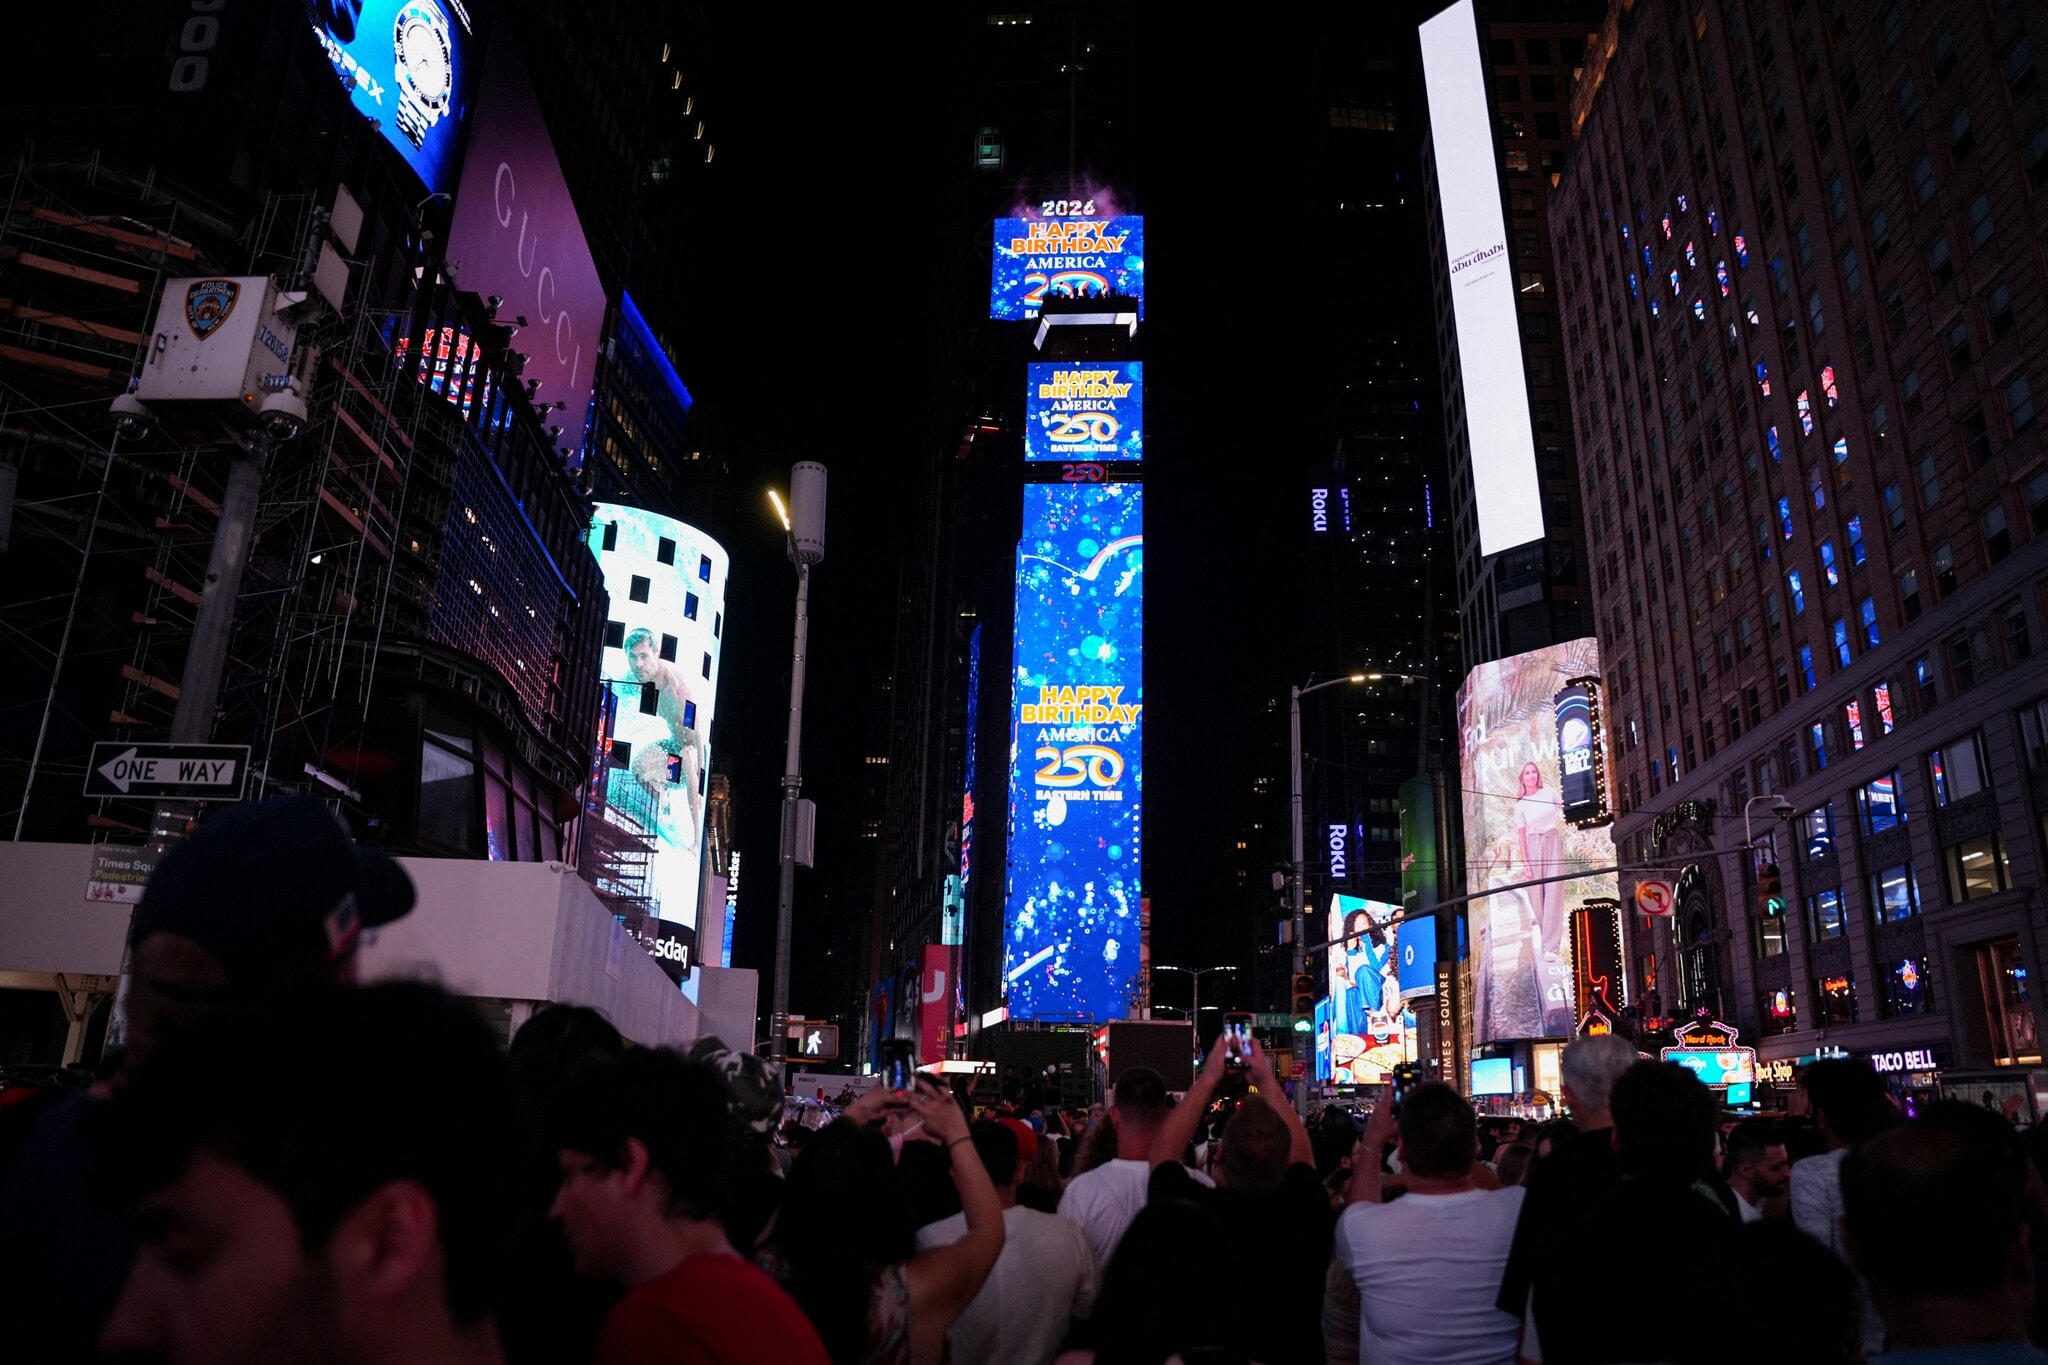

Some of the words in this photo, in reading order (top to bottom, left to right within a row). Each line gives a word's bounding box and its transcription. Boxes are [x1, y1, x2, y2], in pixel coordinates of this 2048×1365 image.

[1042, 200, 1096, 216] 2026
[1029, 221, 1109, 238] HAPPY
[1011, 236, 1126, 254] BIRTHDAY
[1026, 255, 1107, 269] AMERICA
[1451, 259, 1472, 274] abu
[1473, 241, 1504, 264] dhabi
[495, 161, 580, 389] GUCCI
[260, 325, 289, 364] 726158
[264, 375, 291, 387] NYPD
[1053, 370, 1119, 385] HAPPY
[1039, 383, 1133, 399] BIRTHDAY
[1051, 400, 1116, 411] AMERICA
[1050, 412, 1118, 442] 250
[1062, 462, 1105, 481] 250
[1041, 685, 1125, 704] HAPPY
[1021, 703, 1142, 724] BIRTHDAY
[1036, 727, 1121, 742] AMERICA
[1562, 748, 1591, 764] TACO
[113, 760, 158, 780] ONE
[178, 761, 226, 782] WAY
[1035, 745, 1125, 787] 250
[1565, 758, 1592, 775] BELL
[1036, 790, 1090, 801] EASTERN
[98, 857, 131, 870] Times
[133, 860, 157, 873] Squ
[727, 851, 740, 892] Locker
[1438, 972, 1451, 1027] SQUARE
[1258, 1015, 1266, 1026] W
[1270, 1015, 1281, 1025] 44
[1685, 1034, 1705, 1045] Hard
[1706, 1034, 1727, 1046] Rock
[1441, 1039, 1453, 1082] TIMES
[1872, 1052, 1903, 1072] TACO
[1904, 1049, 1937, 1070] BELL
[1755, 1062, 1773, 1083] Rock
[1773, 1060, 1793, 1082] Shop
